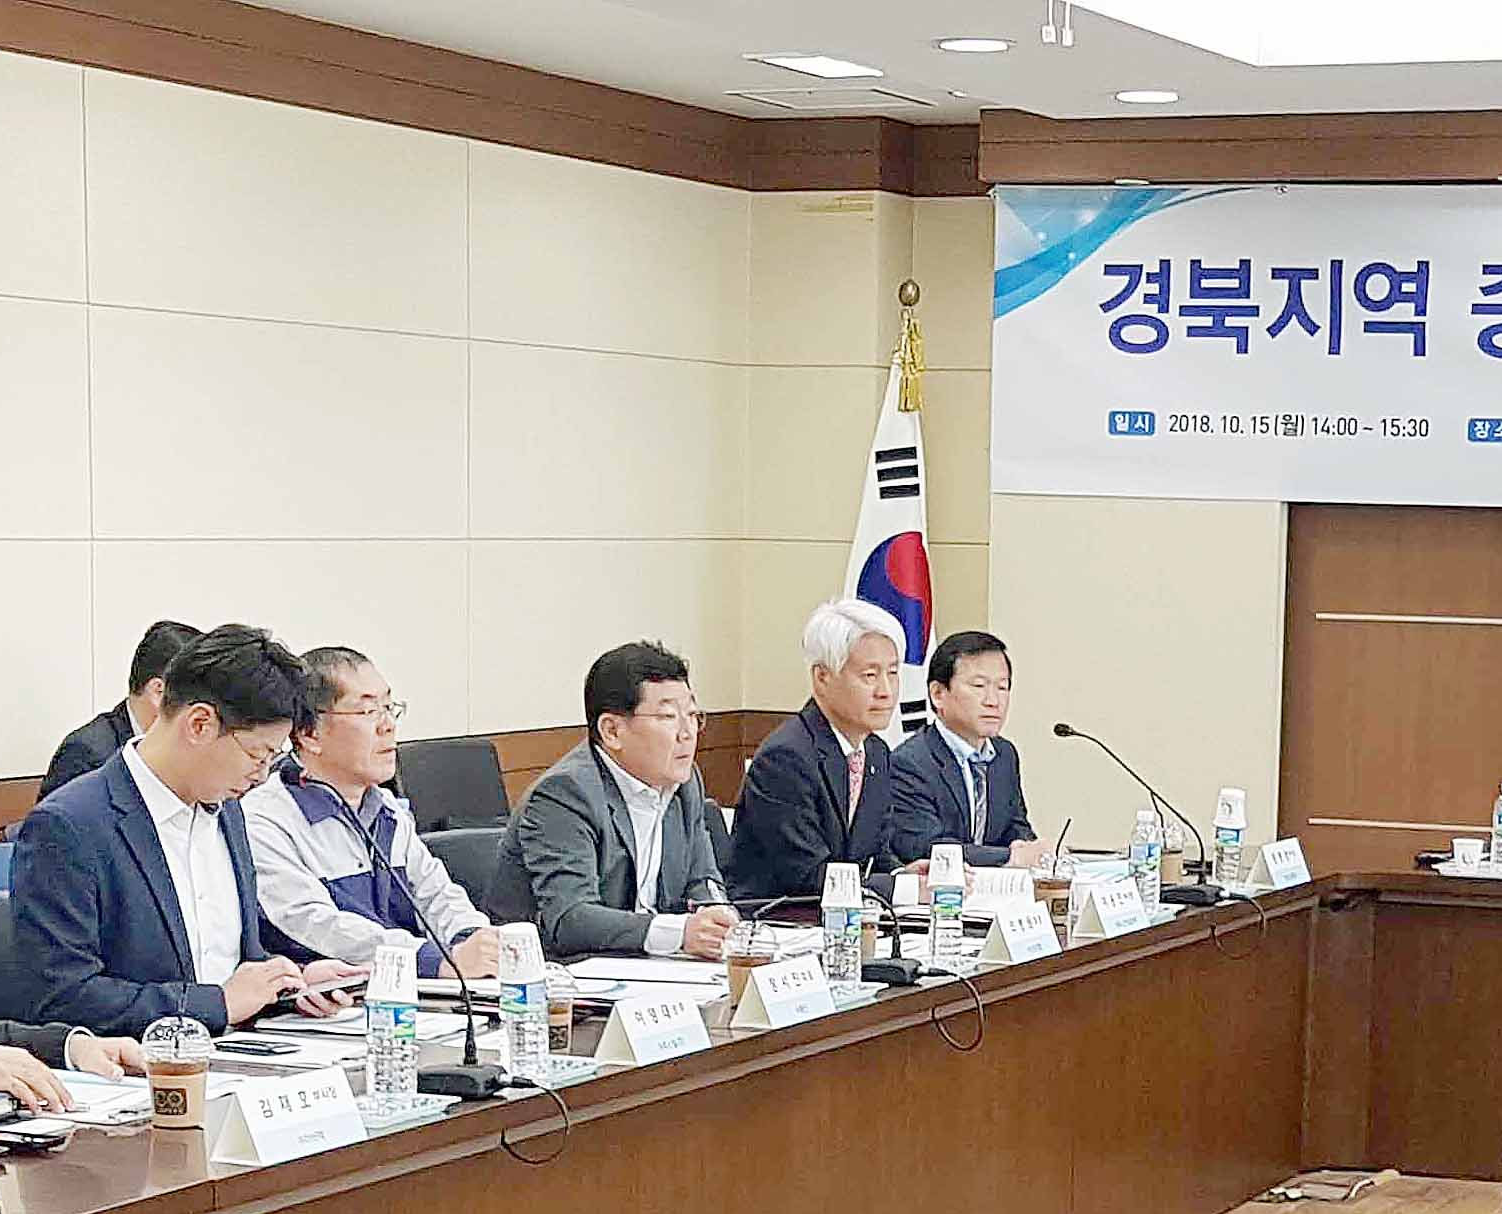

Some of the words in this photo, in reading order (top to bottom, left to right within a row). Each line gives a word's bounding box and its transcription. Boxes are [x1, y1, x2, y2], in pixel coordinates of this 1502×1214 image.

[1098, 259, 1430, 357] 경북지역
[1113, 413, 1152, 433] 일시
[1169, 414, 1214, 434] 2018.
[1222, 415, 1244, 434] 10.
[1250, 413, 1305, 437] 15(월)
[1313, 416, 1358, 436] 14:00
[1381, 417, 1429, 437] 15:30
